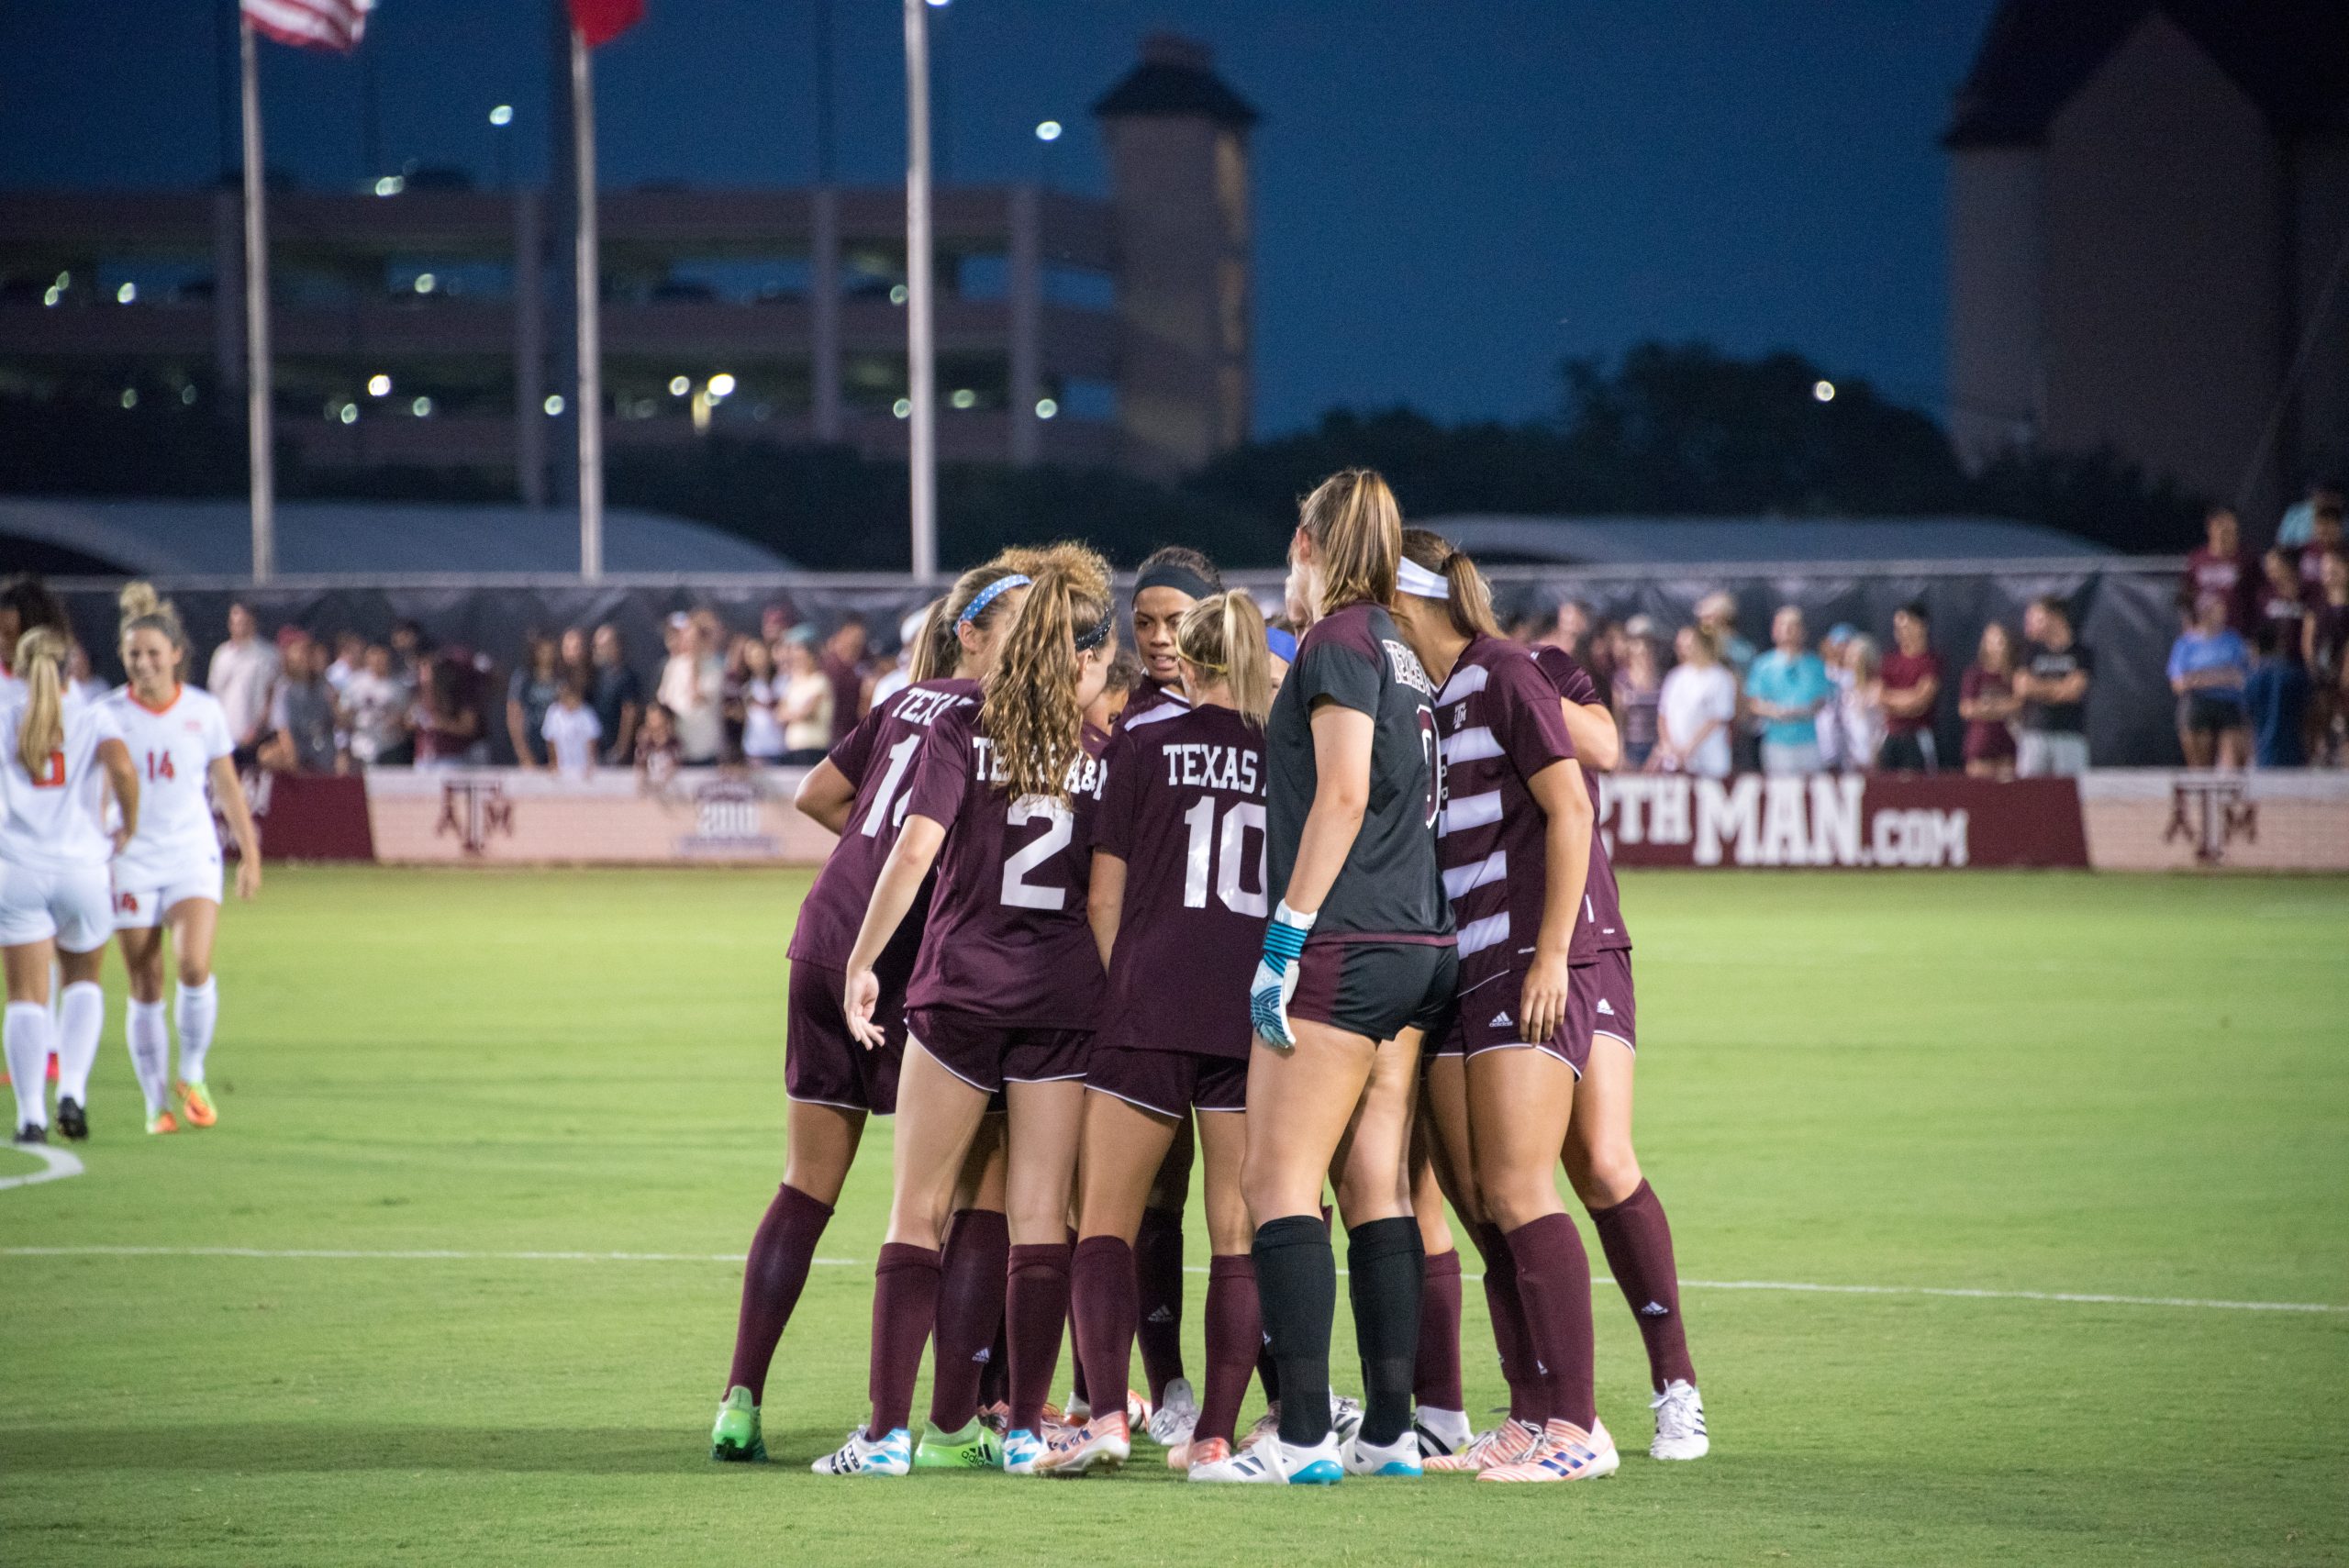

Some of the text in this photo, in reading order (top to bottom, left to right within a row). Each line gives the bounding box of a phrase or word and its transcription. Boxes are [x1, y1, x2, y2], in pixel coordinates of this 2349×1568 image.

[147, 750, 174, 783] 14
[861, 734, 918, 838] 1
[1163, 744, 1258, 794] TEXAS
[1000, 793, 1074, 909] 2
[1184, 795, 1267, 918] 10
